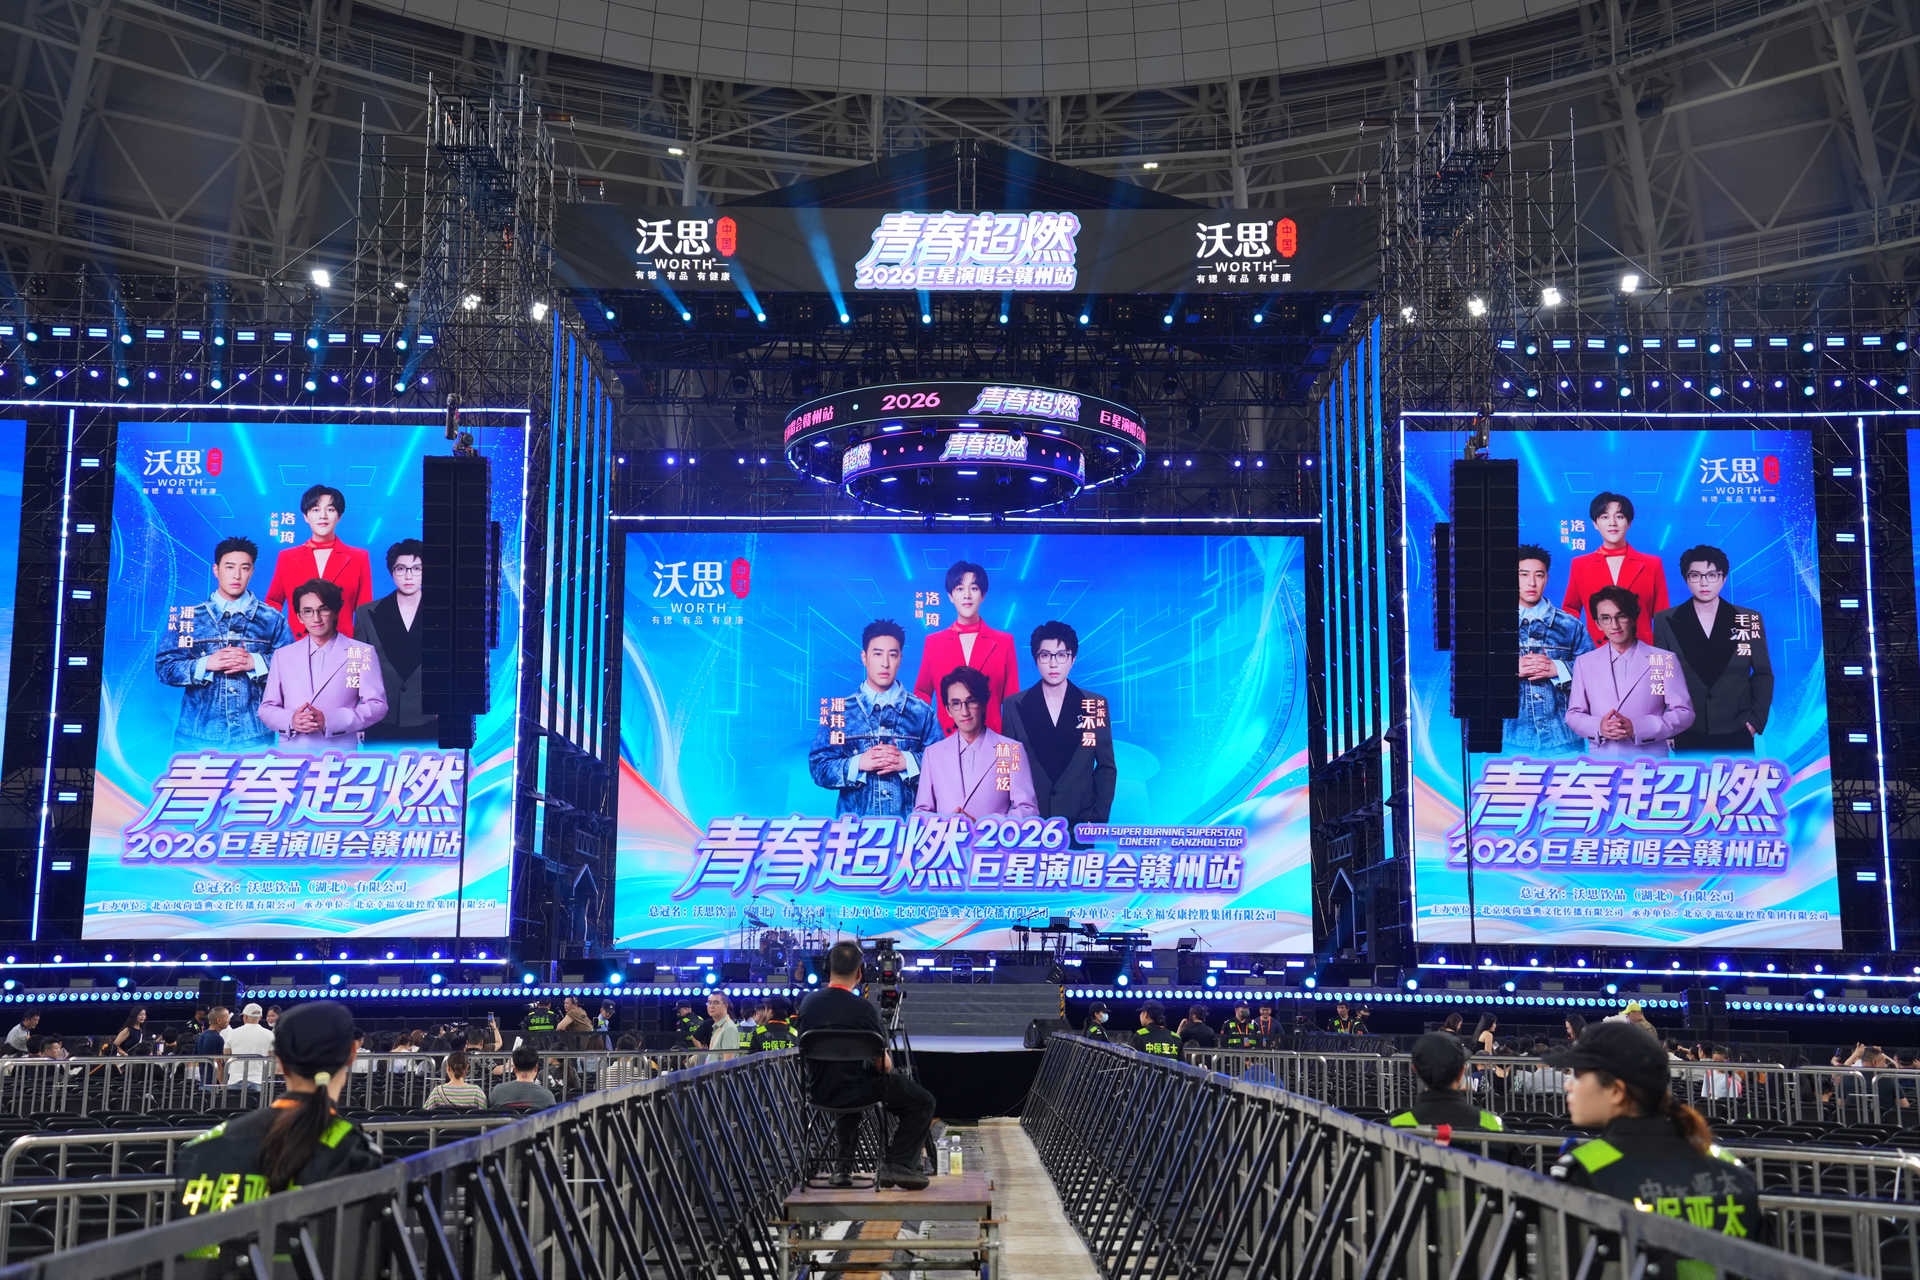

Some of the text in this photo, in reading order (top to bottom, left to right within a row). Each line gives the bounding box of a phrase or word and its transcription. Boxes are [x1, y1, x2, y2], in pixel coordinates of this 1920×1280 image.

[636, 218, 711, 255] 沃思
[857, 214, 1075, 266] 青春超燃
[1196, 222, 1271, 258] 沃思
[654, 258, 712, 270] WORTH
[859, 266, 1075, 286] 2026巨星演唱会赣州站
[1216, 261, 1273, 273] WORTH
[881, 392, 941, 411] 2026
[970, 388, 1080, 420] 青春超燃
[940, 433, 1028, 461] 青春超燃
[143, 449, 202, 476] 沃思
[1700, 458, 1759, 484] 沃思
[158, 479, 203, 487] WORTH
[1716, 487, 1761, 495] WORTH
[653, 561, 725, 598] 沃思
[671, 603, 726, 613] WORTH
[1735, 614, 1751, 656] 毛不易
[1081, 699, 1096, 747] 毛不易
[128, 754, 464, 834] 青春超燃
[1450, 760, 1784, 838] 青春超燃
[126, 830, 462, 860] 2026巨星演唱会赣州站
[974, 818, 1064, 849] 2026
[1078, 826, 1243, 837] YOUTH SUPER BURNING SUPERSTAR
[1119, 837, 1243, 847] CONCERT GANZHOU STOP
[672, 815, 970, 898] 青春超燃
[1449, 838, 1787, 868] 2026巨星演唱会赣州站
[970, 852, 1242, 889] 巨星演唱会赣州站
